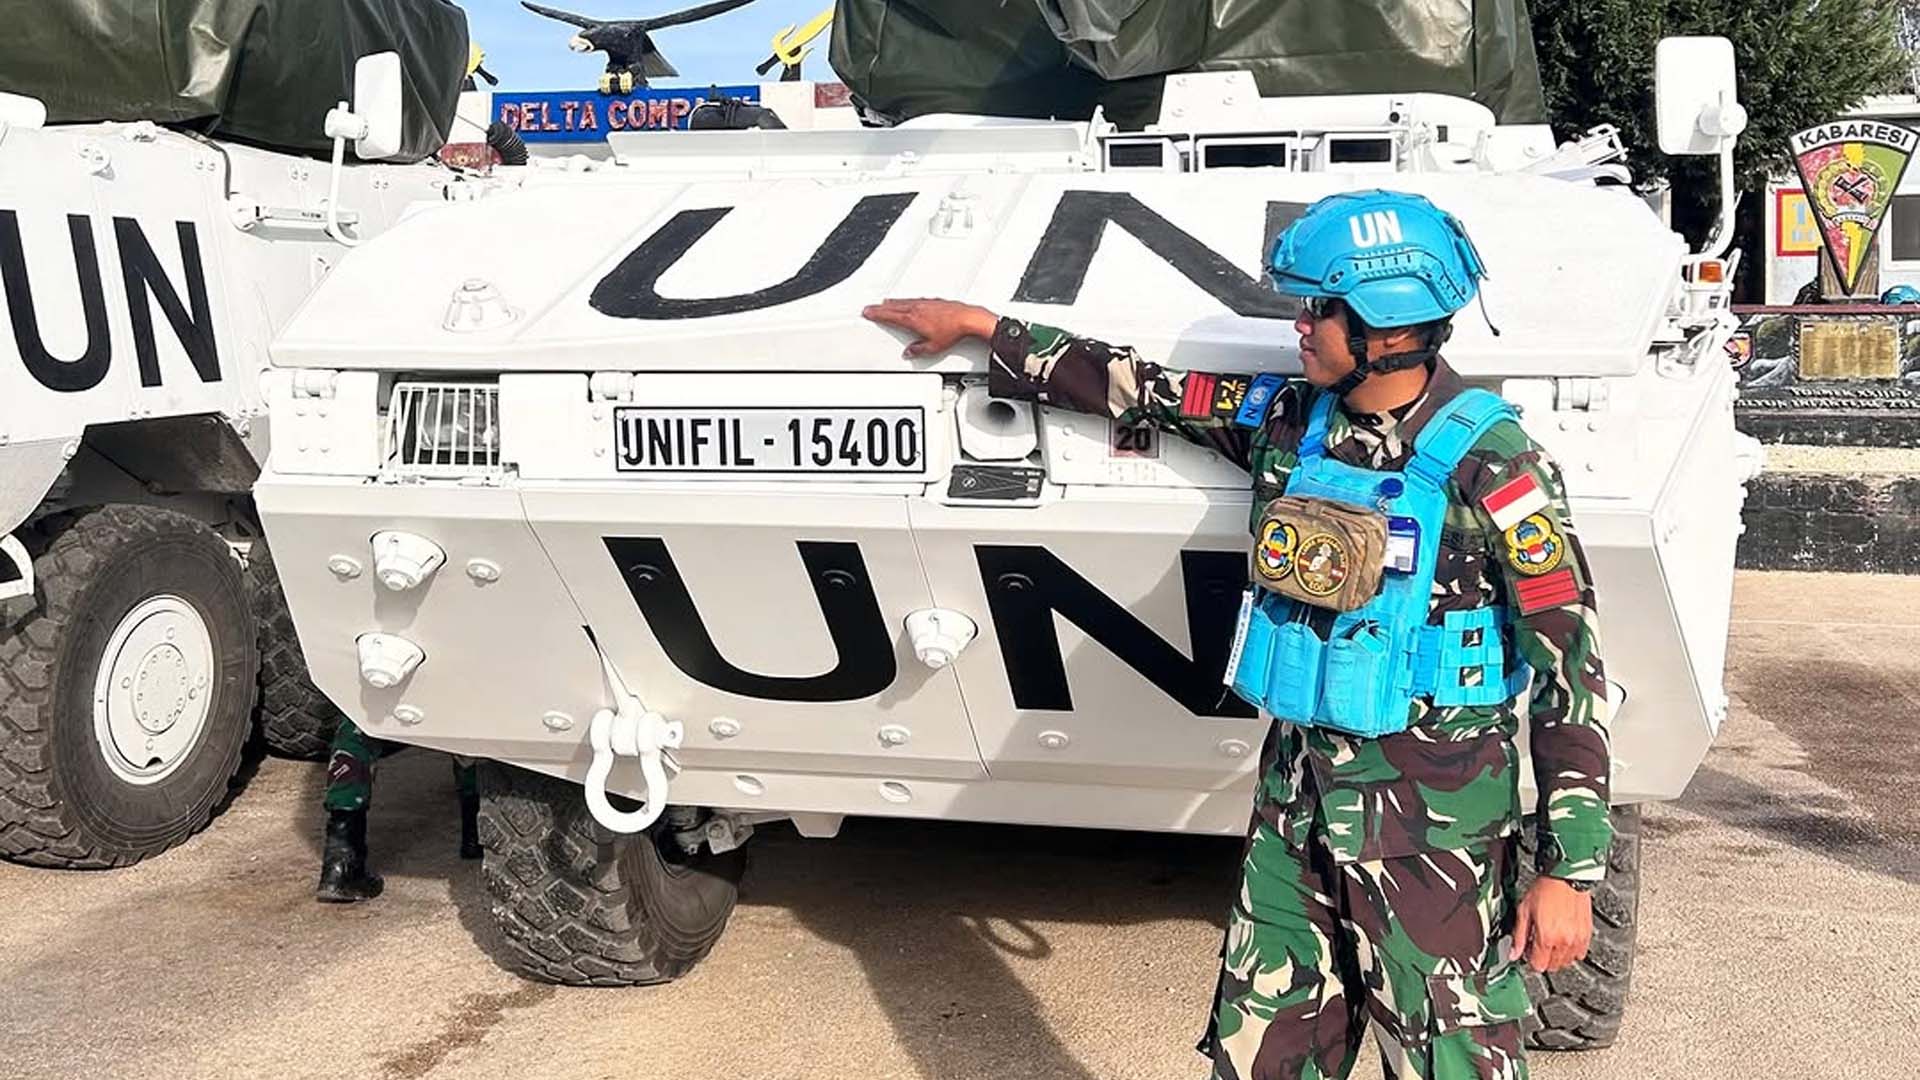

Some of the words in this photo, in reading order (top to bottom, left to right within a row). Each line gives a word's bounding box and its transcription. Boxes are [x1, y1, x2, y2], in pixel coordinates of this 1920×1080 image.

[500, 101, 598, 131] DELTA
[1799, 123, 1909, 148] KABARESI
[1349, 210, 1403, 248] UN
[588, 191, 1312, 320] UN
[0, 209, 222, 392] UN
[1117, 425, 1151, 451] 20
[602, 536, 1259, 719] UN
